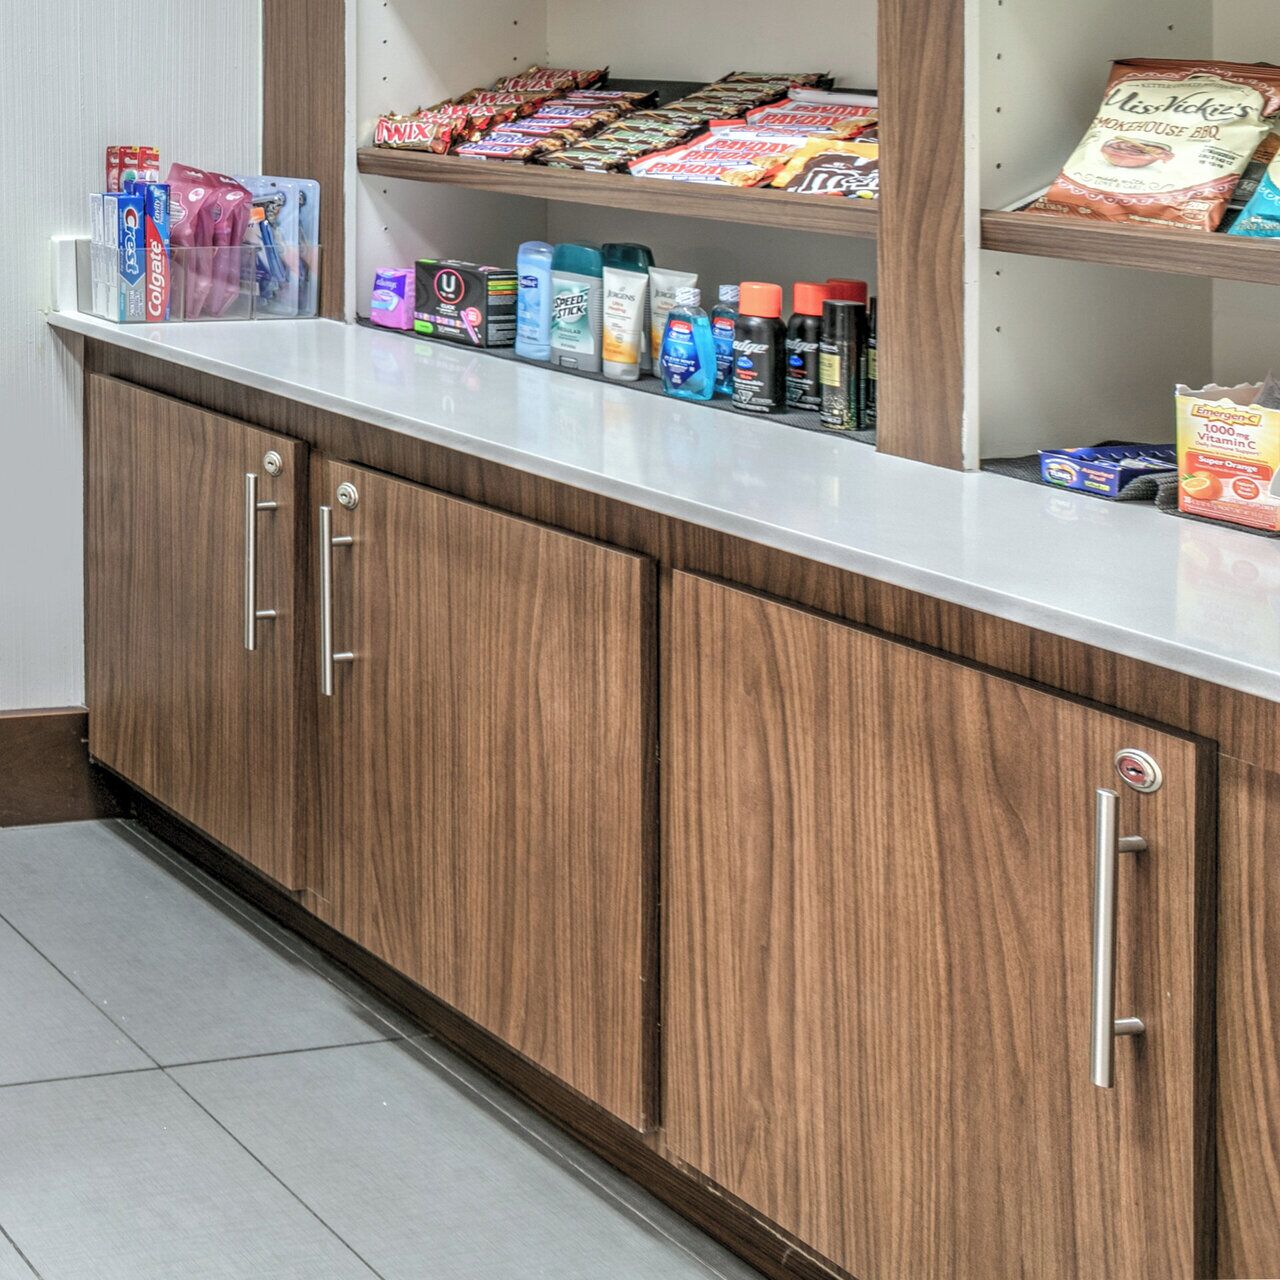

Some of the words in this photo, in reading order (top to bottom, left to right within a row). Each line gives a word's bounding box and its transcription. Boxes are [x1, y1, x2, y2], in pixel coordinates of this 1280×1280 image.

[375, 117, 431, 144] TWIX
[1190, 125, 1221, 141] BBQ
[124, 207, 140, 275] Crest
[148, 239, 166, 317] Colgate
[554, 295, 584, 309] SPEED
[607, 289, 636, 301] JERGENS
[557, 304, 586, 319] STICK
[732, 339, 769, 355] edge
[1195, 406, 1258, 424] Emergen-C
[1197, 431, 1246, 448] Vitamin
[1247, 441, 1256, 450] C
[1198, 455, 1223, 468] Super
[1225, 460, 1258, 473] Orange
